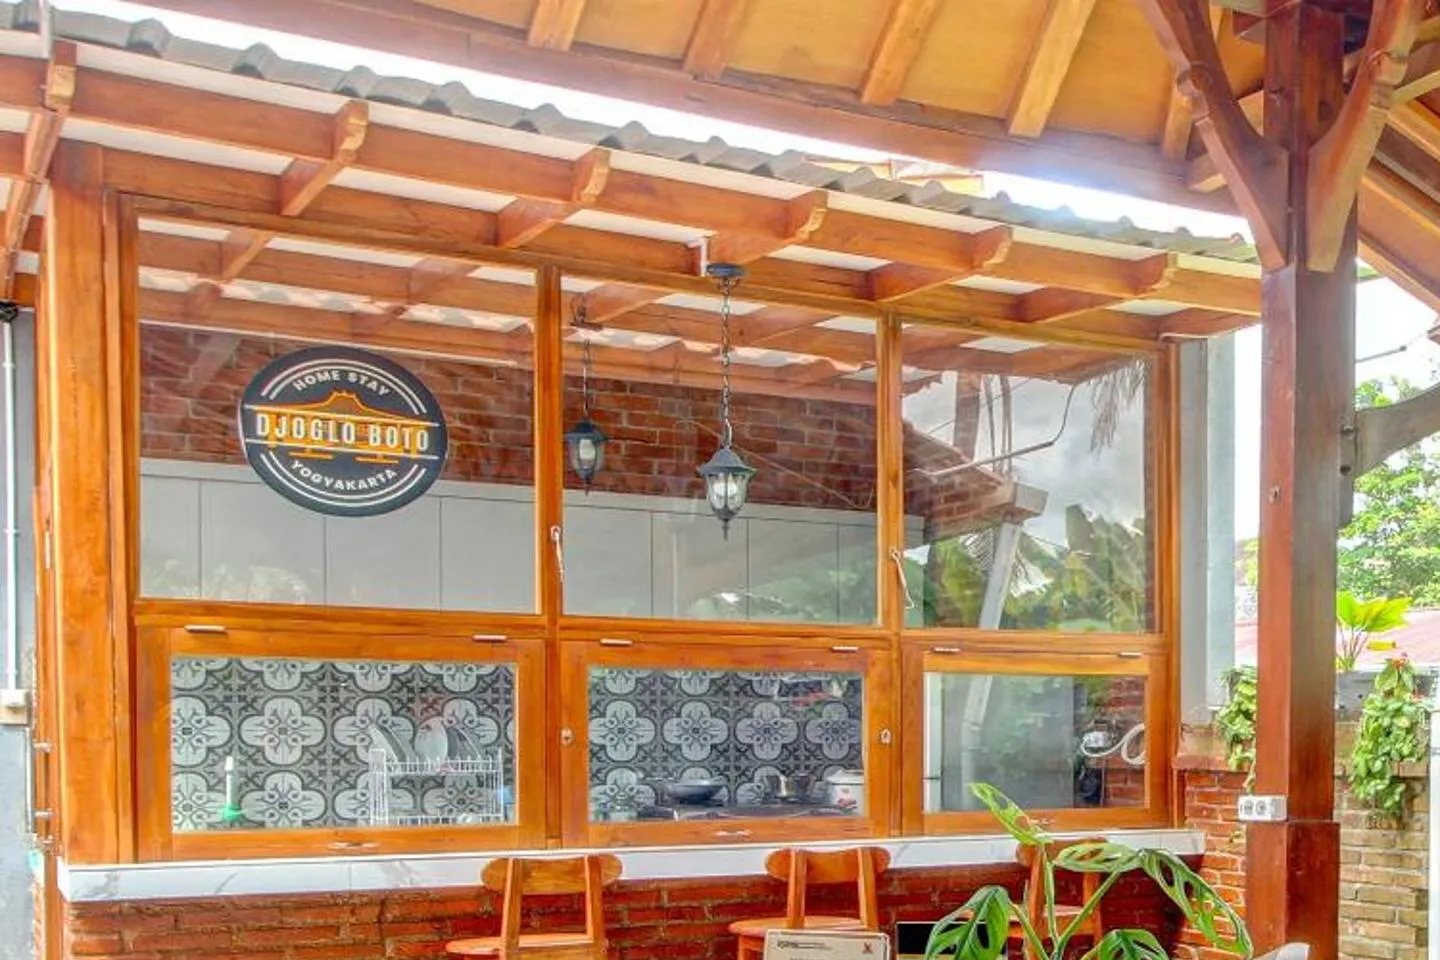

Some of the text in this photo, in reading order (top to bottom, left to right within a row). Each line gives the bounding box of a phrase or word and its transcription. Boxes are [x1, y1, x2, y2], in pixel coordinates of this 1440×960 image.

[292, 370, 391, 396] HOME STAY
[256, 412, 429, 450] DJOGLO BOTO
[291, 459, 398, 491] YOGYAKARTA
